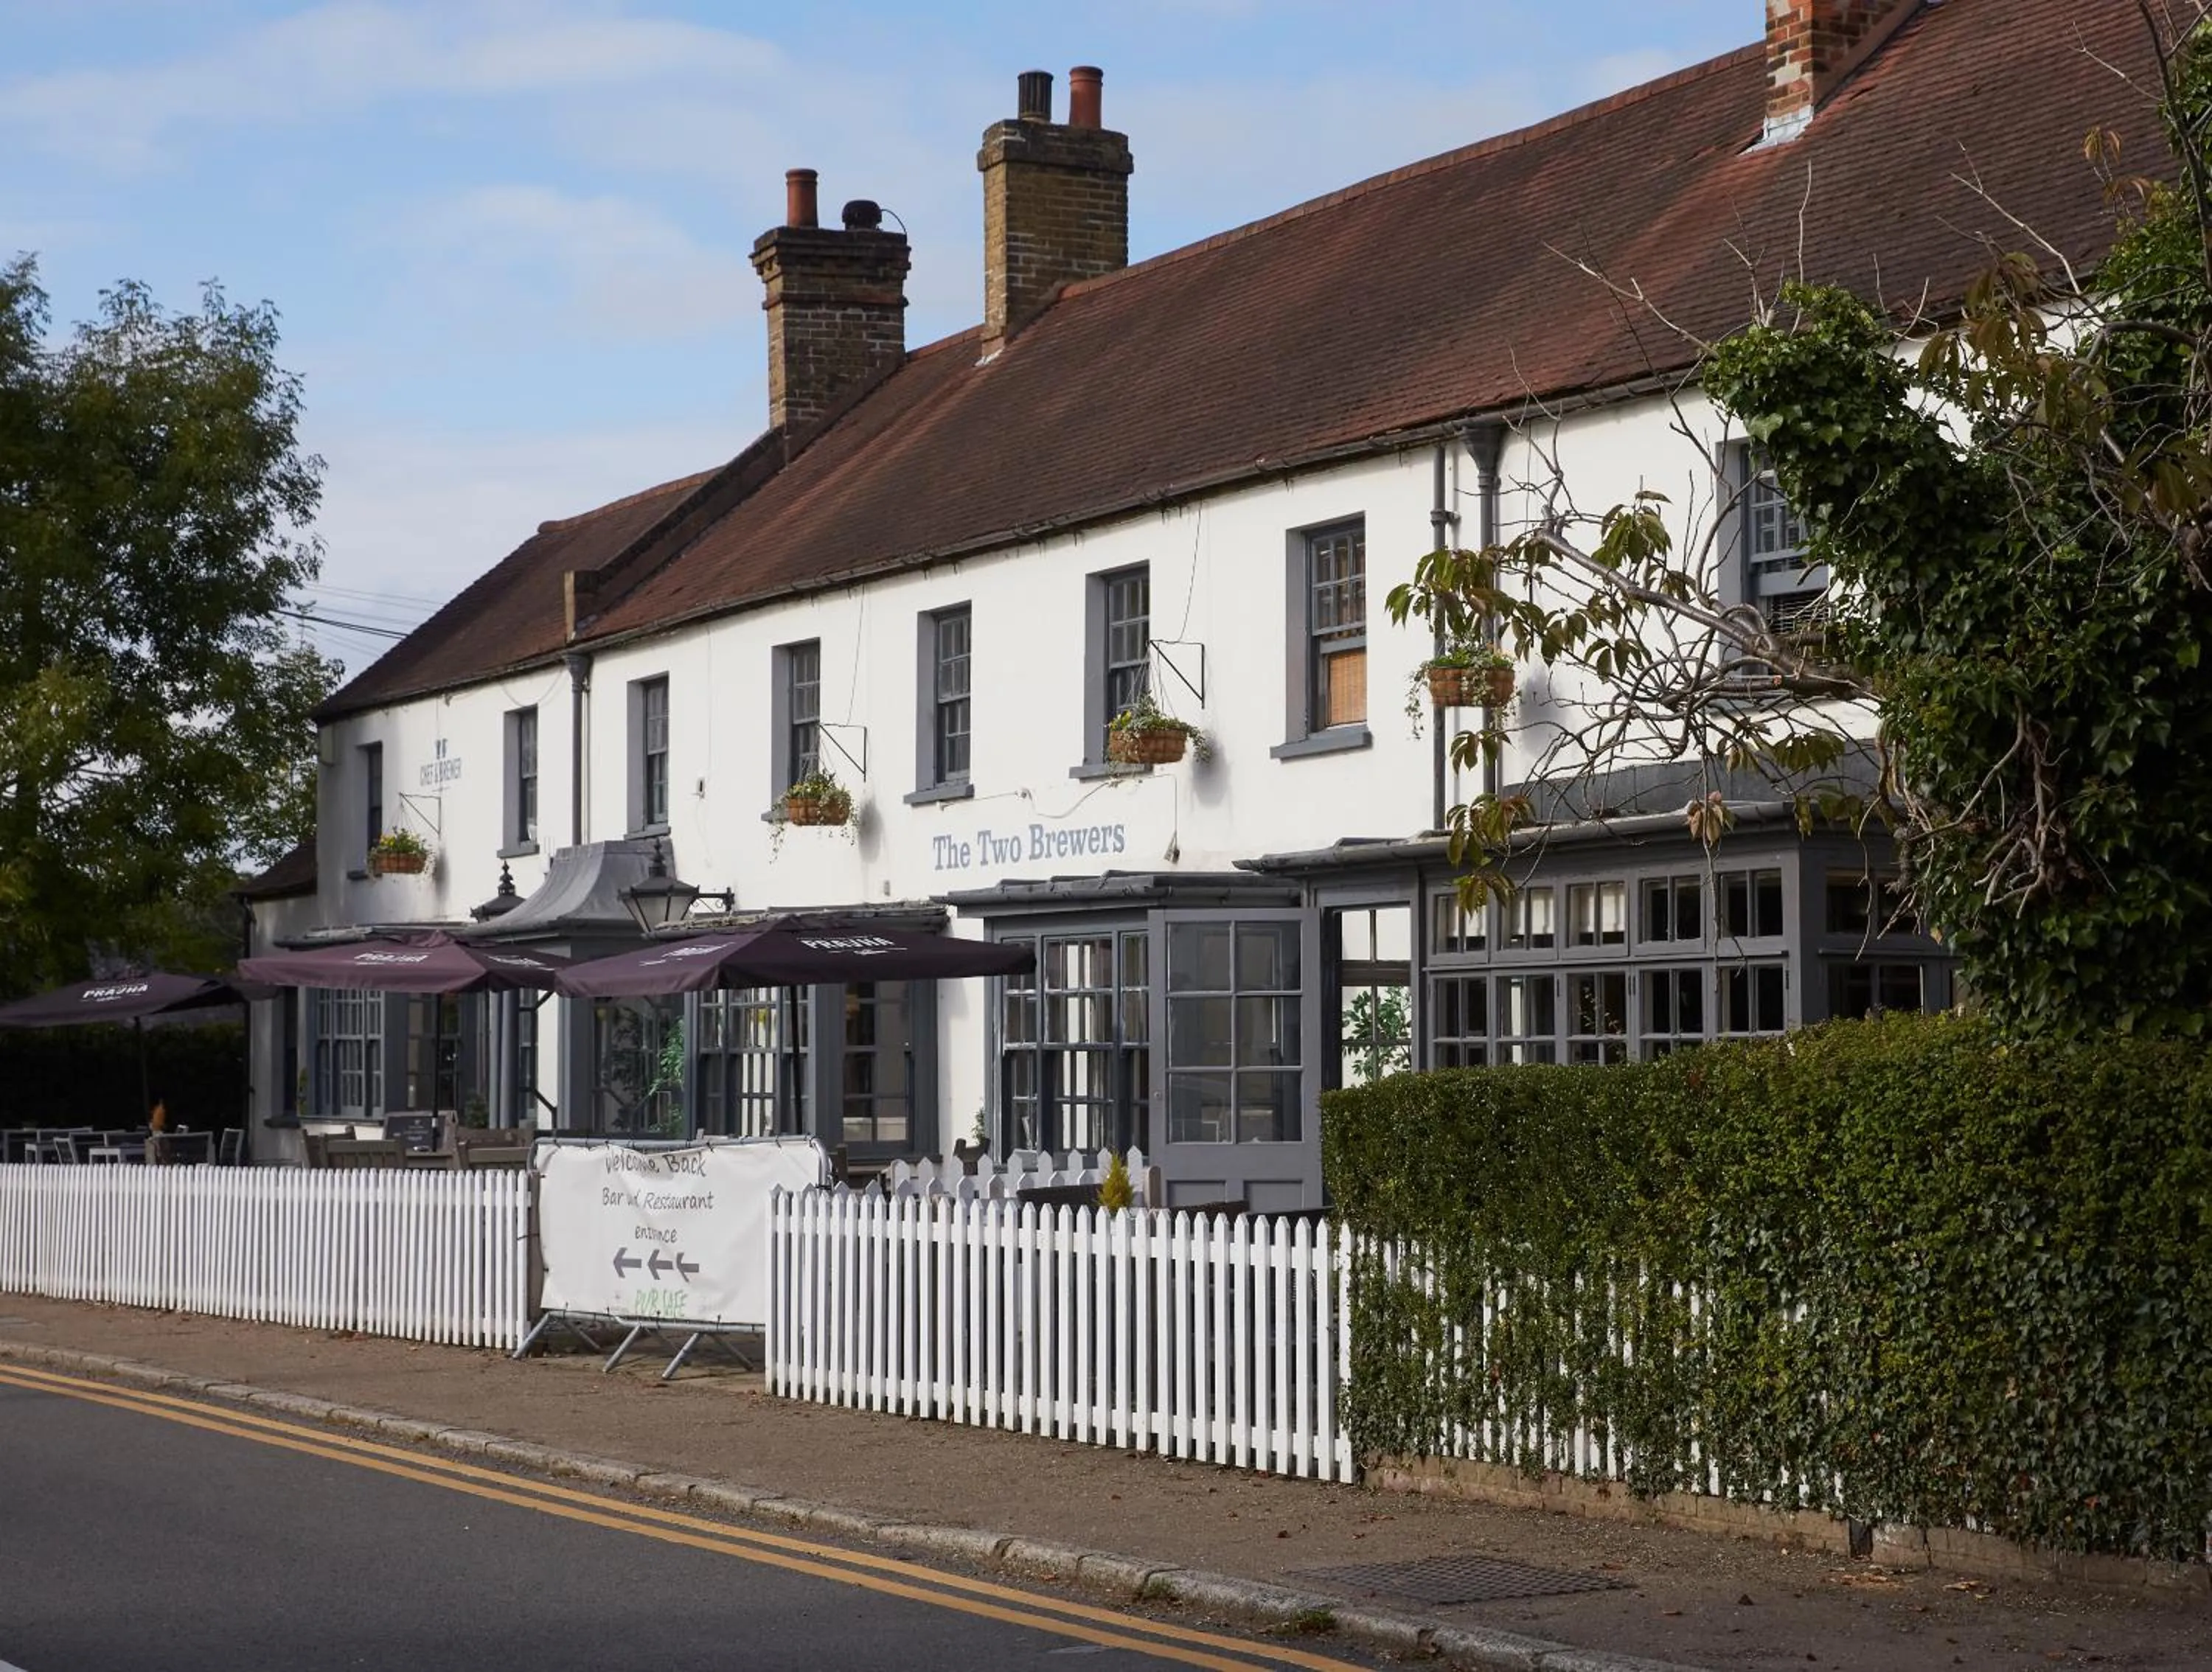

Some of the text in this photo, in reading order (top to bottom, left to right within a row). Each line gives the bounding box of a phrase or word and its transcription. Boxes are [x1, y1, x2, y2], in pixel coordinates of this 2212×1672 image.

[933, 823, 1125, 871] The Two Brewers
[662, 1151, 706, 1177] Back
[602, 1186, 624, 1206] Bar
[643, 1191, 714, 1211] Restaurant
